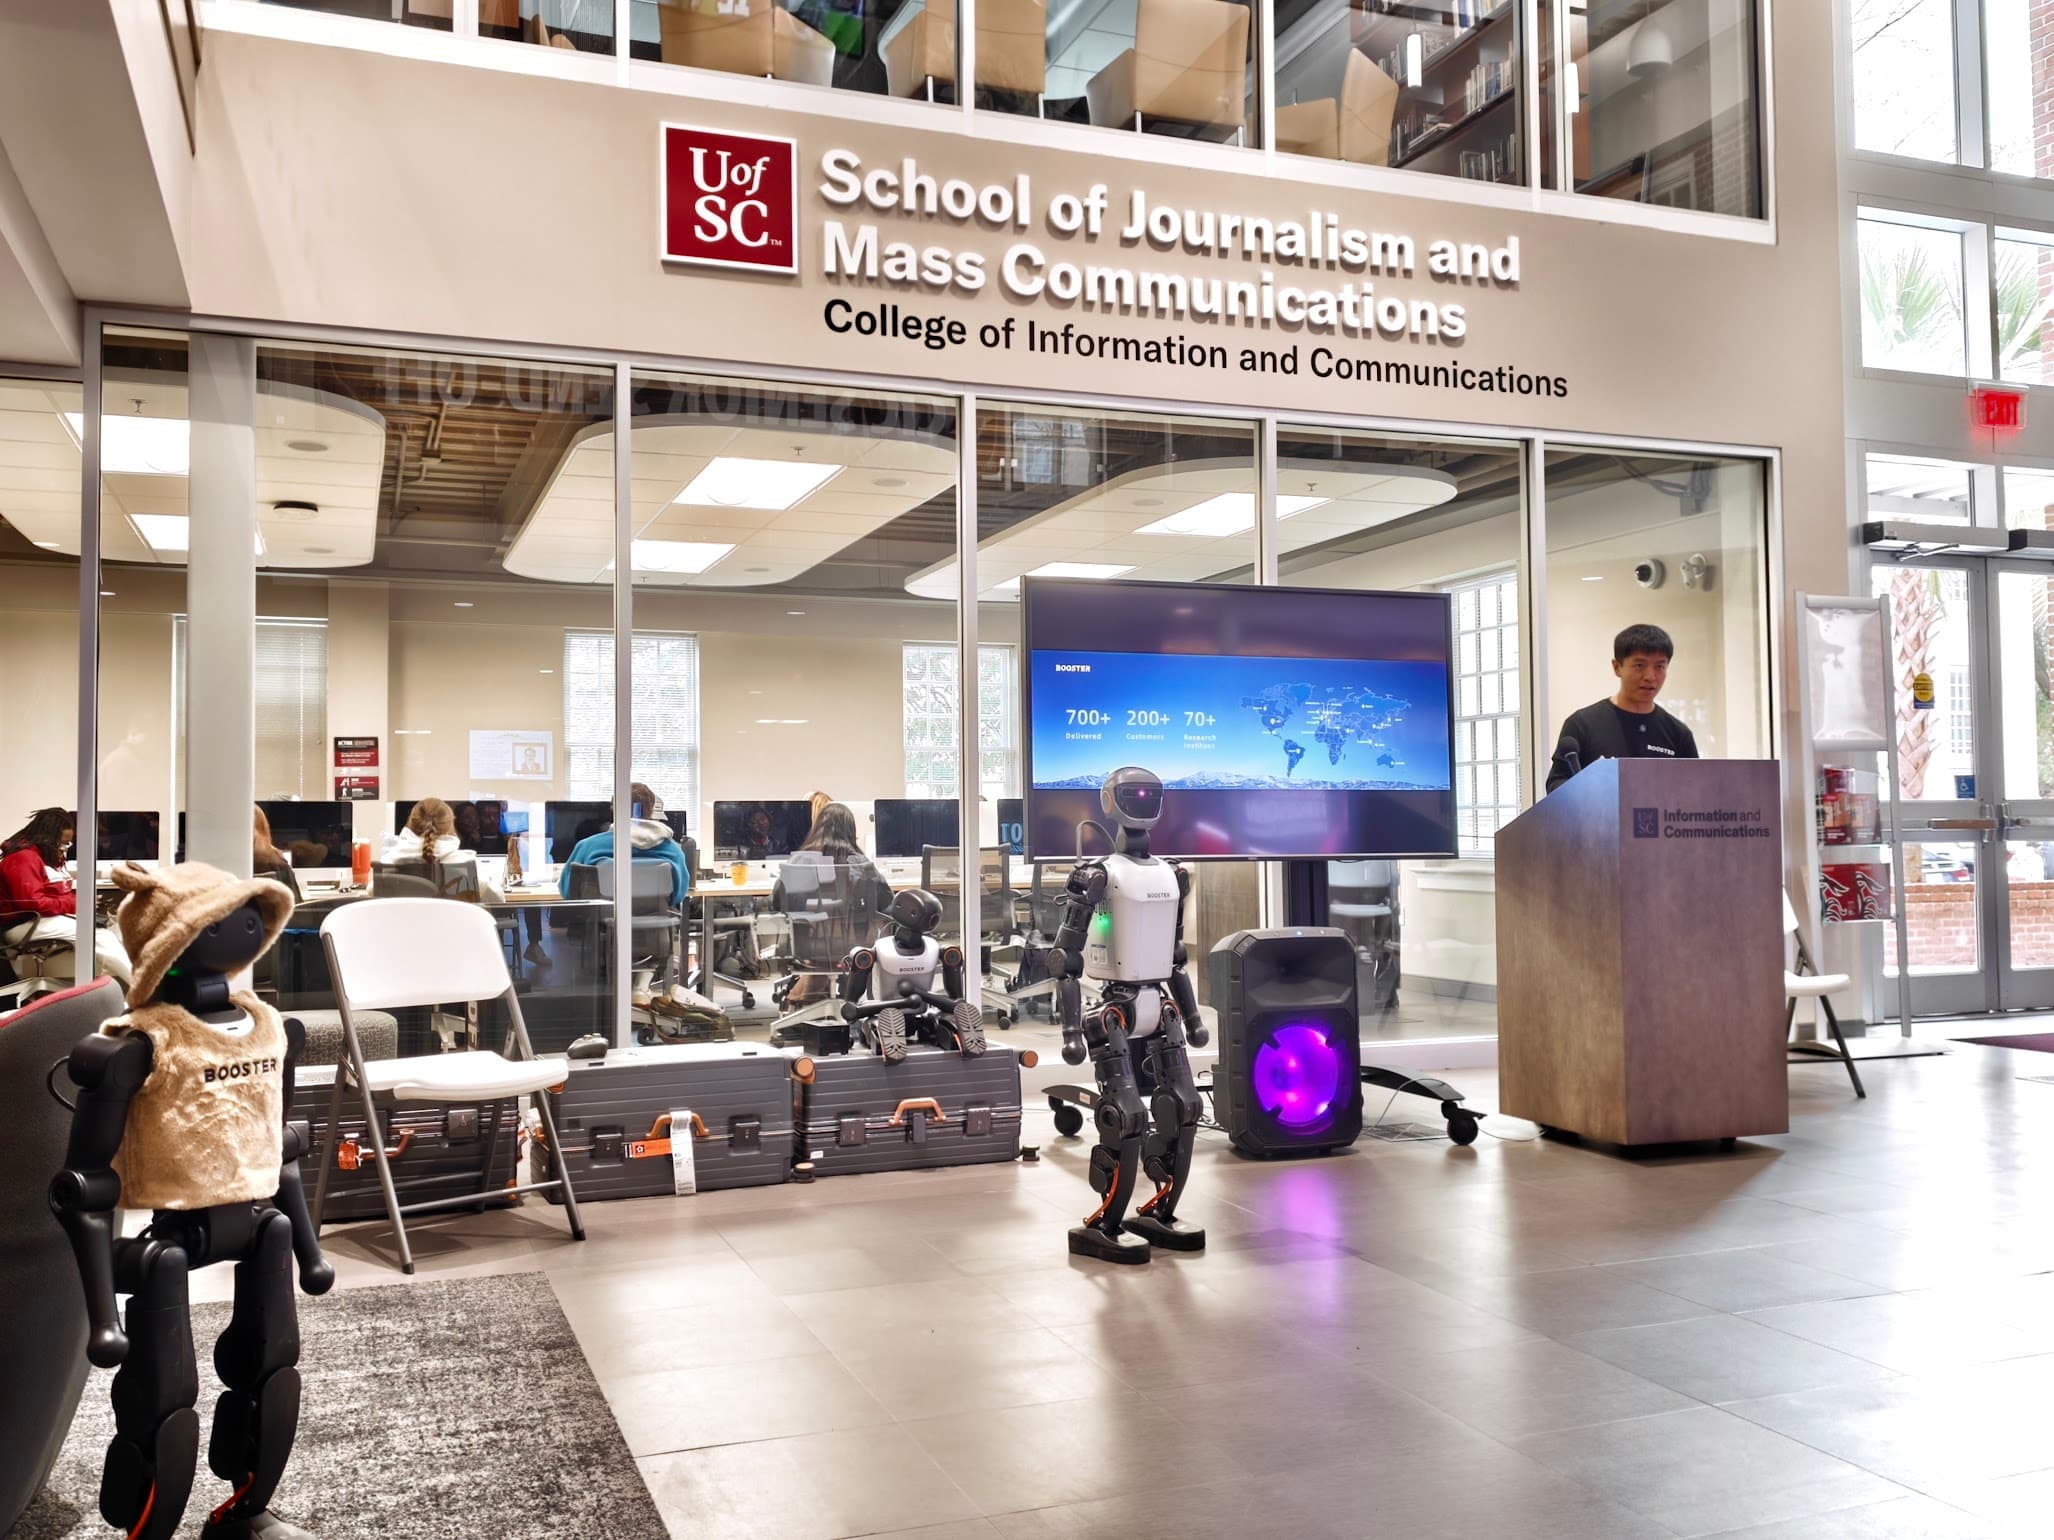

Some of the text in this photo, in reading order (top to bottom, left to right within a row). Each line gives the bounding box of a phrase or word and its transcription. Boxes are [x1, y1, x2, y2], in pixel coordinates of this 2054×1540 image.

[693, 194, 769, 248] SC
[819, 148, 1520, 283] School of Journalism and
[823, 220, 1467, 339] Mass Communications
[823, 299, 1568, 398] College of Information and Communications
[1055, 664, 1091, 673] BOOSTER
[1065, 708, 1217, 728] 700+ 200+ 70+
[1065, 732, 1102, 740] Delivered
[1126, 733, 1165, 741] Customers
[1183, 734, 1217, 742] Research
[1647, 744, 1676, 757] BOOSTER
[1663, 808, 1761, 822] Information and
[1663, 825, 1770, 839] Communications
[203, 1058, 278, 1083] BOOSTER
